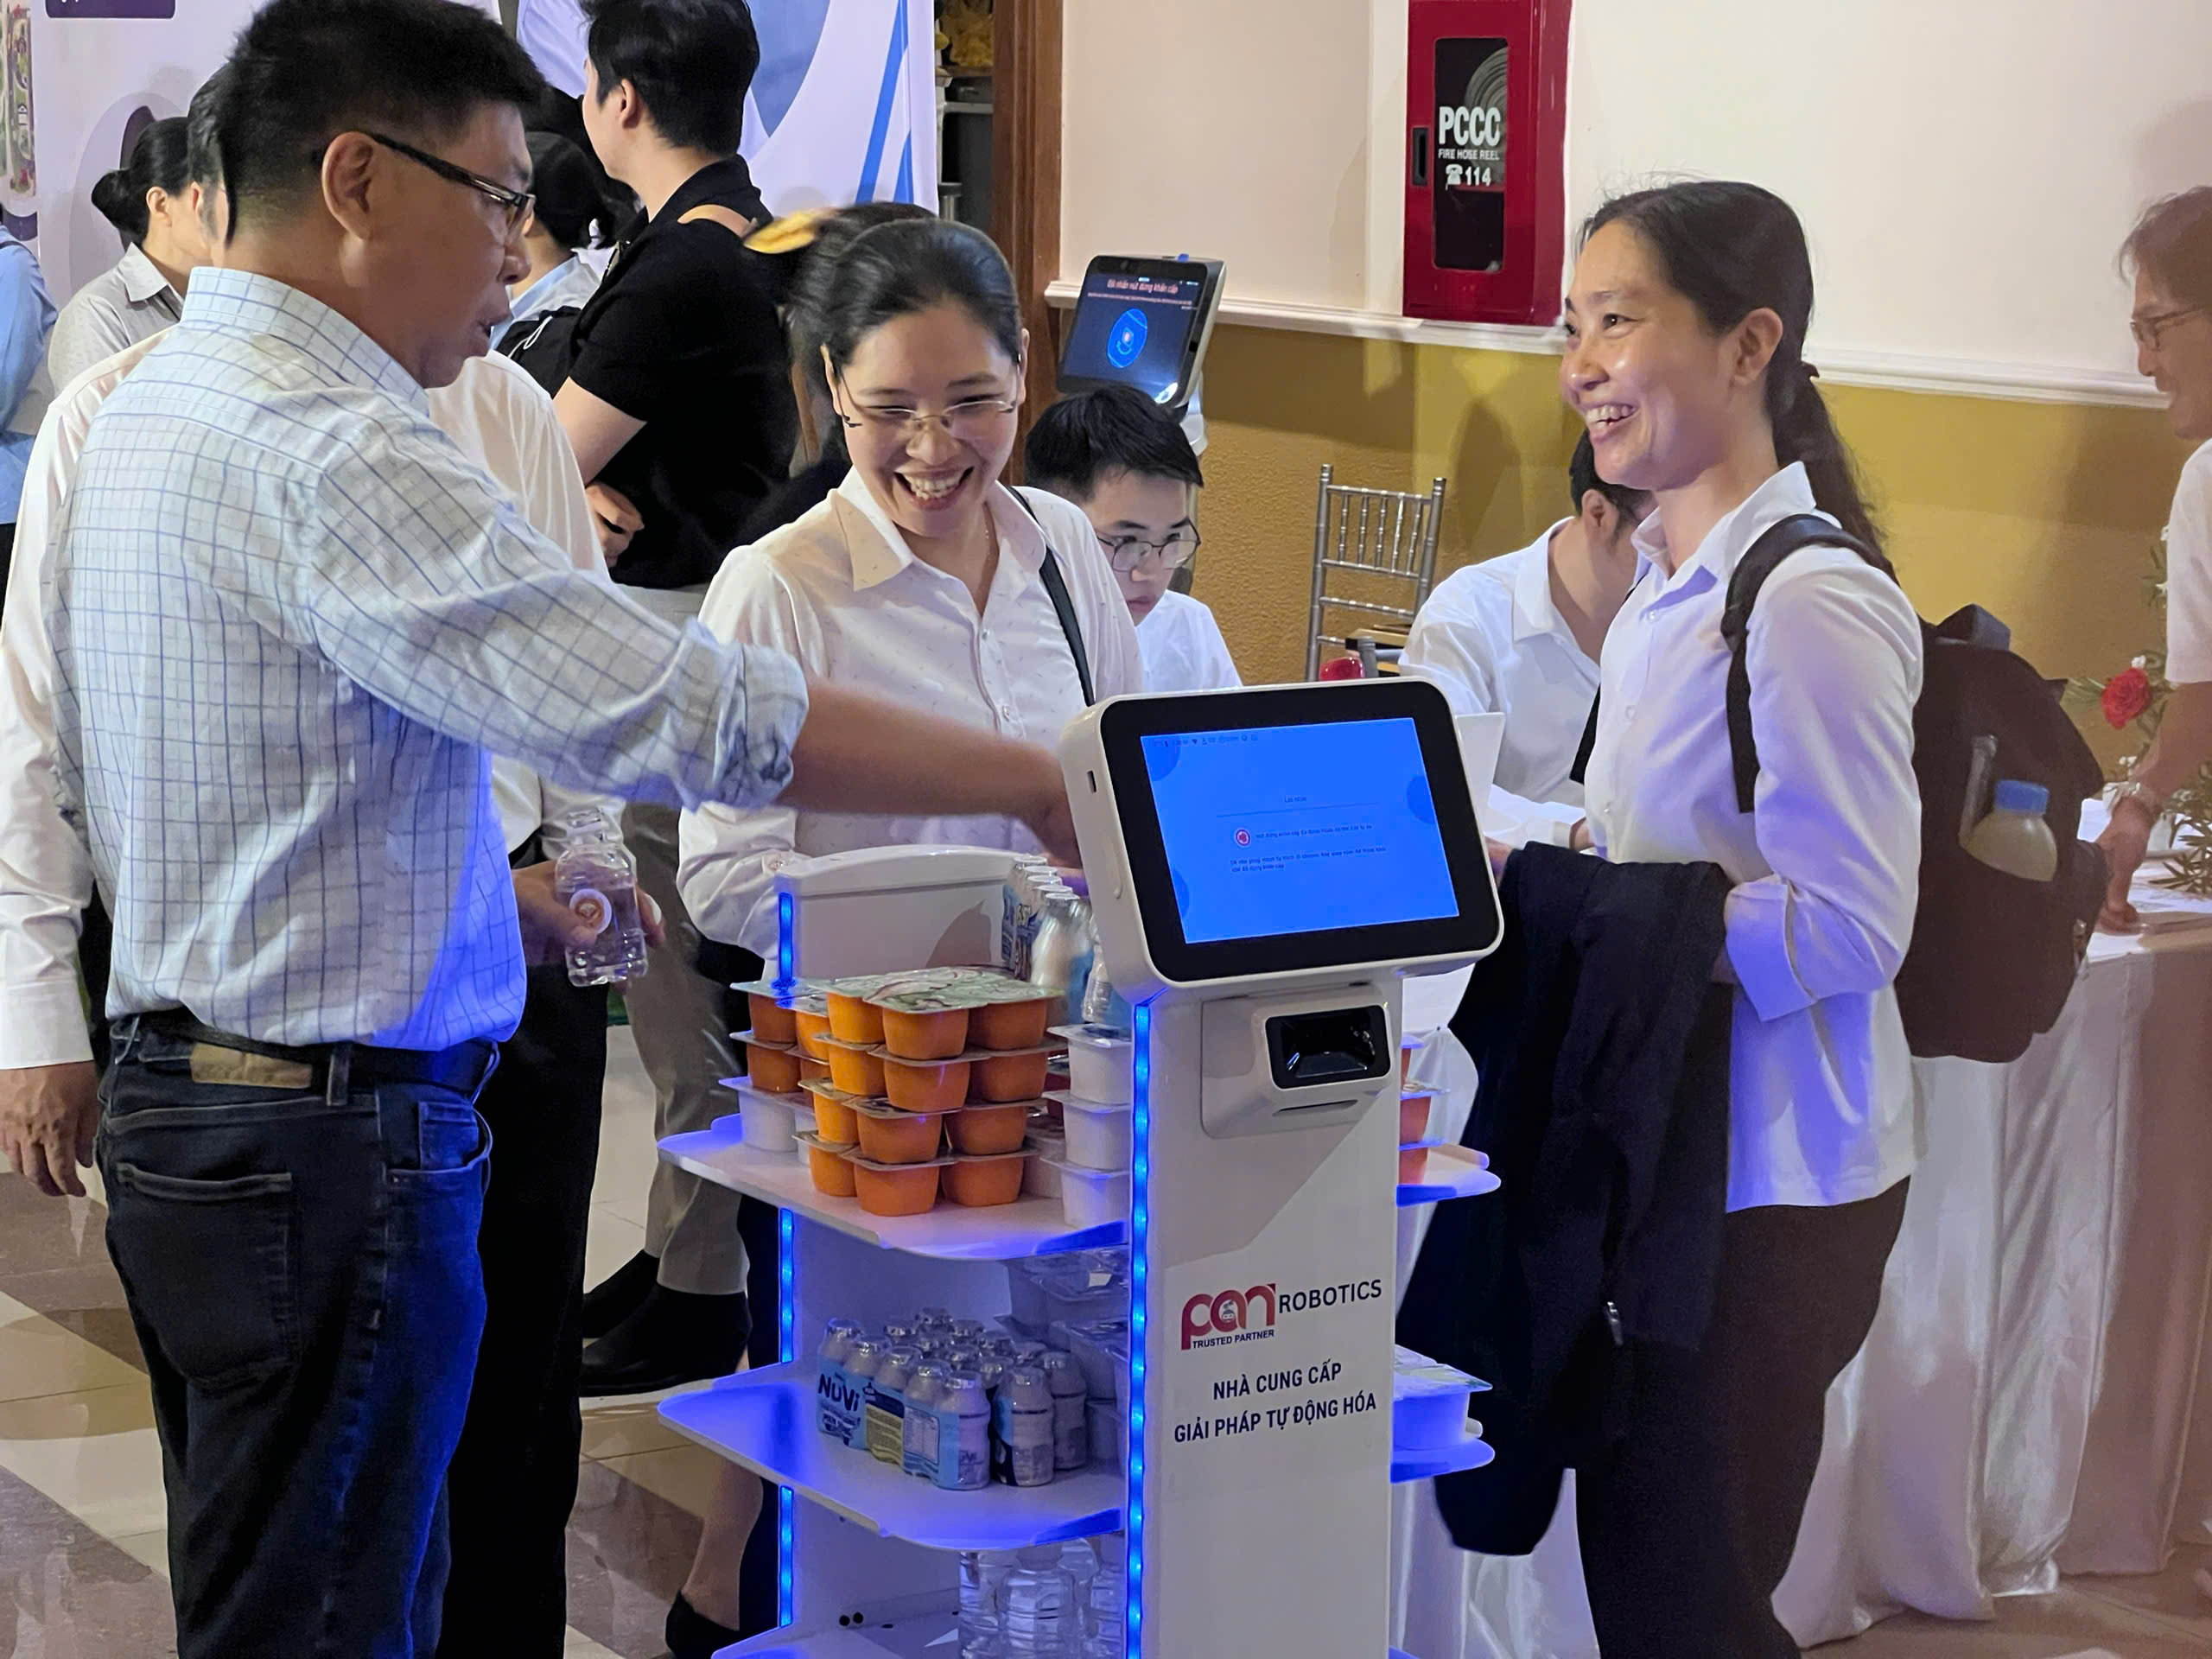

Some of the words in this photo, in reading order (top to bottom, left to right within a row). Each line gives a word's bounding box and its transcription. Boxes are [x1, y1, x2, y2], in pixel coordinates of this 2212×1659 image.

[1439, 105, 1501, 147] PCCC
[1438, 148, 1456, 159] FIRE
[1457, 149, 1478, 160] HOSE
[1479, 149, 1500, 161] REEL
[1465, 166, 1491, 187] 114
[1278, 1279, 1382, 1314] ROBOTICS
[1192, 1335, 1233, 1350] TRUSTED
[1234, 1329, 1274, 1343] PARTNER
[1213, 1373, 1251, 1401] NHÀ
[1255, 1369, 1303, 1393] CUNG
[1308, 1358, 1342, 1384] CẤP
[1174, 1416, 1210, 1443] GIẢI
[1214, 1410, 1262, 1437] PHÁP
[1266, 1406, 1291, 1430] TỰ
[1293, 1399, 1338, 1426] ĐỘNG
[1343, 1389, 1377, 1415] HÓA
